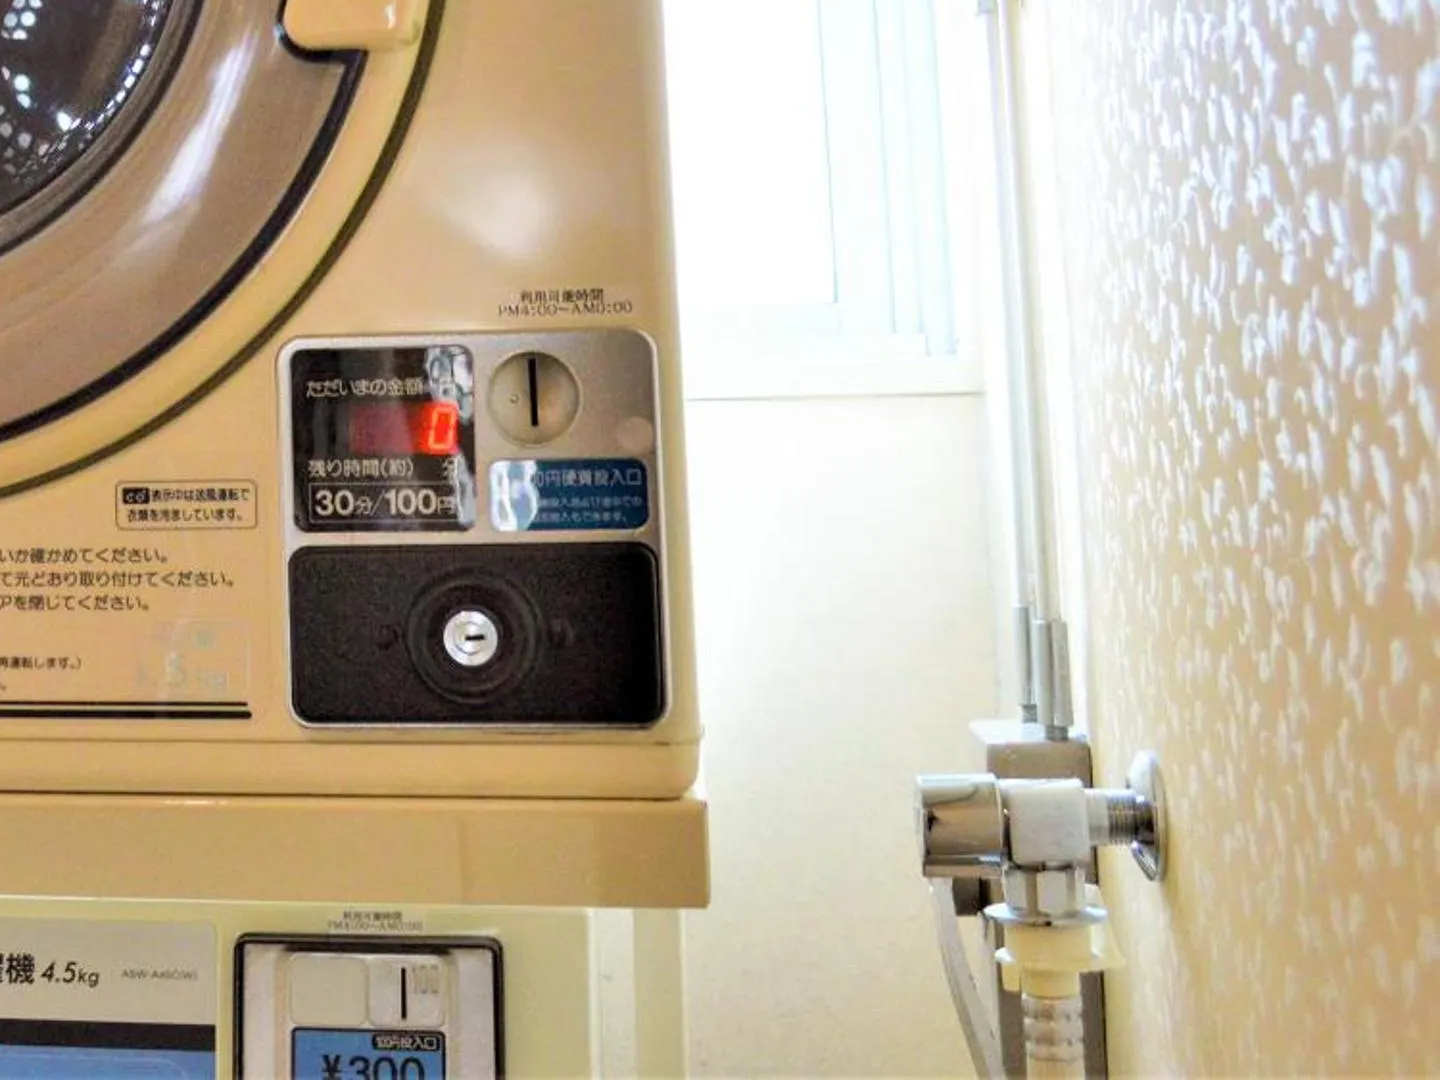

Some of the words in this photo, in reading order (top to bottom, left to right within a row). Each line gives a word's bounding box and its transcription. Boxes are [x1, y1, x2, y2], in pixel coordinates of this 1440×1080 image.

[306, 377, 424, 398] ただいまの金額
[428, 406, 457, 451] 0
[41, 961, 100, 988] 4.5kg
